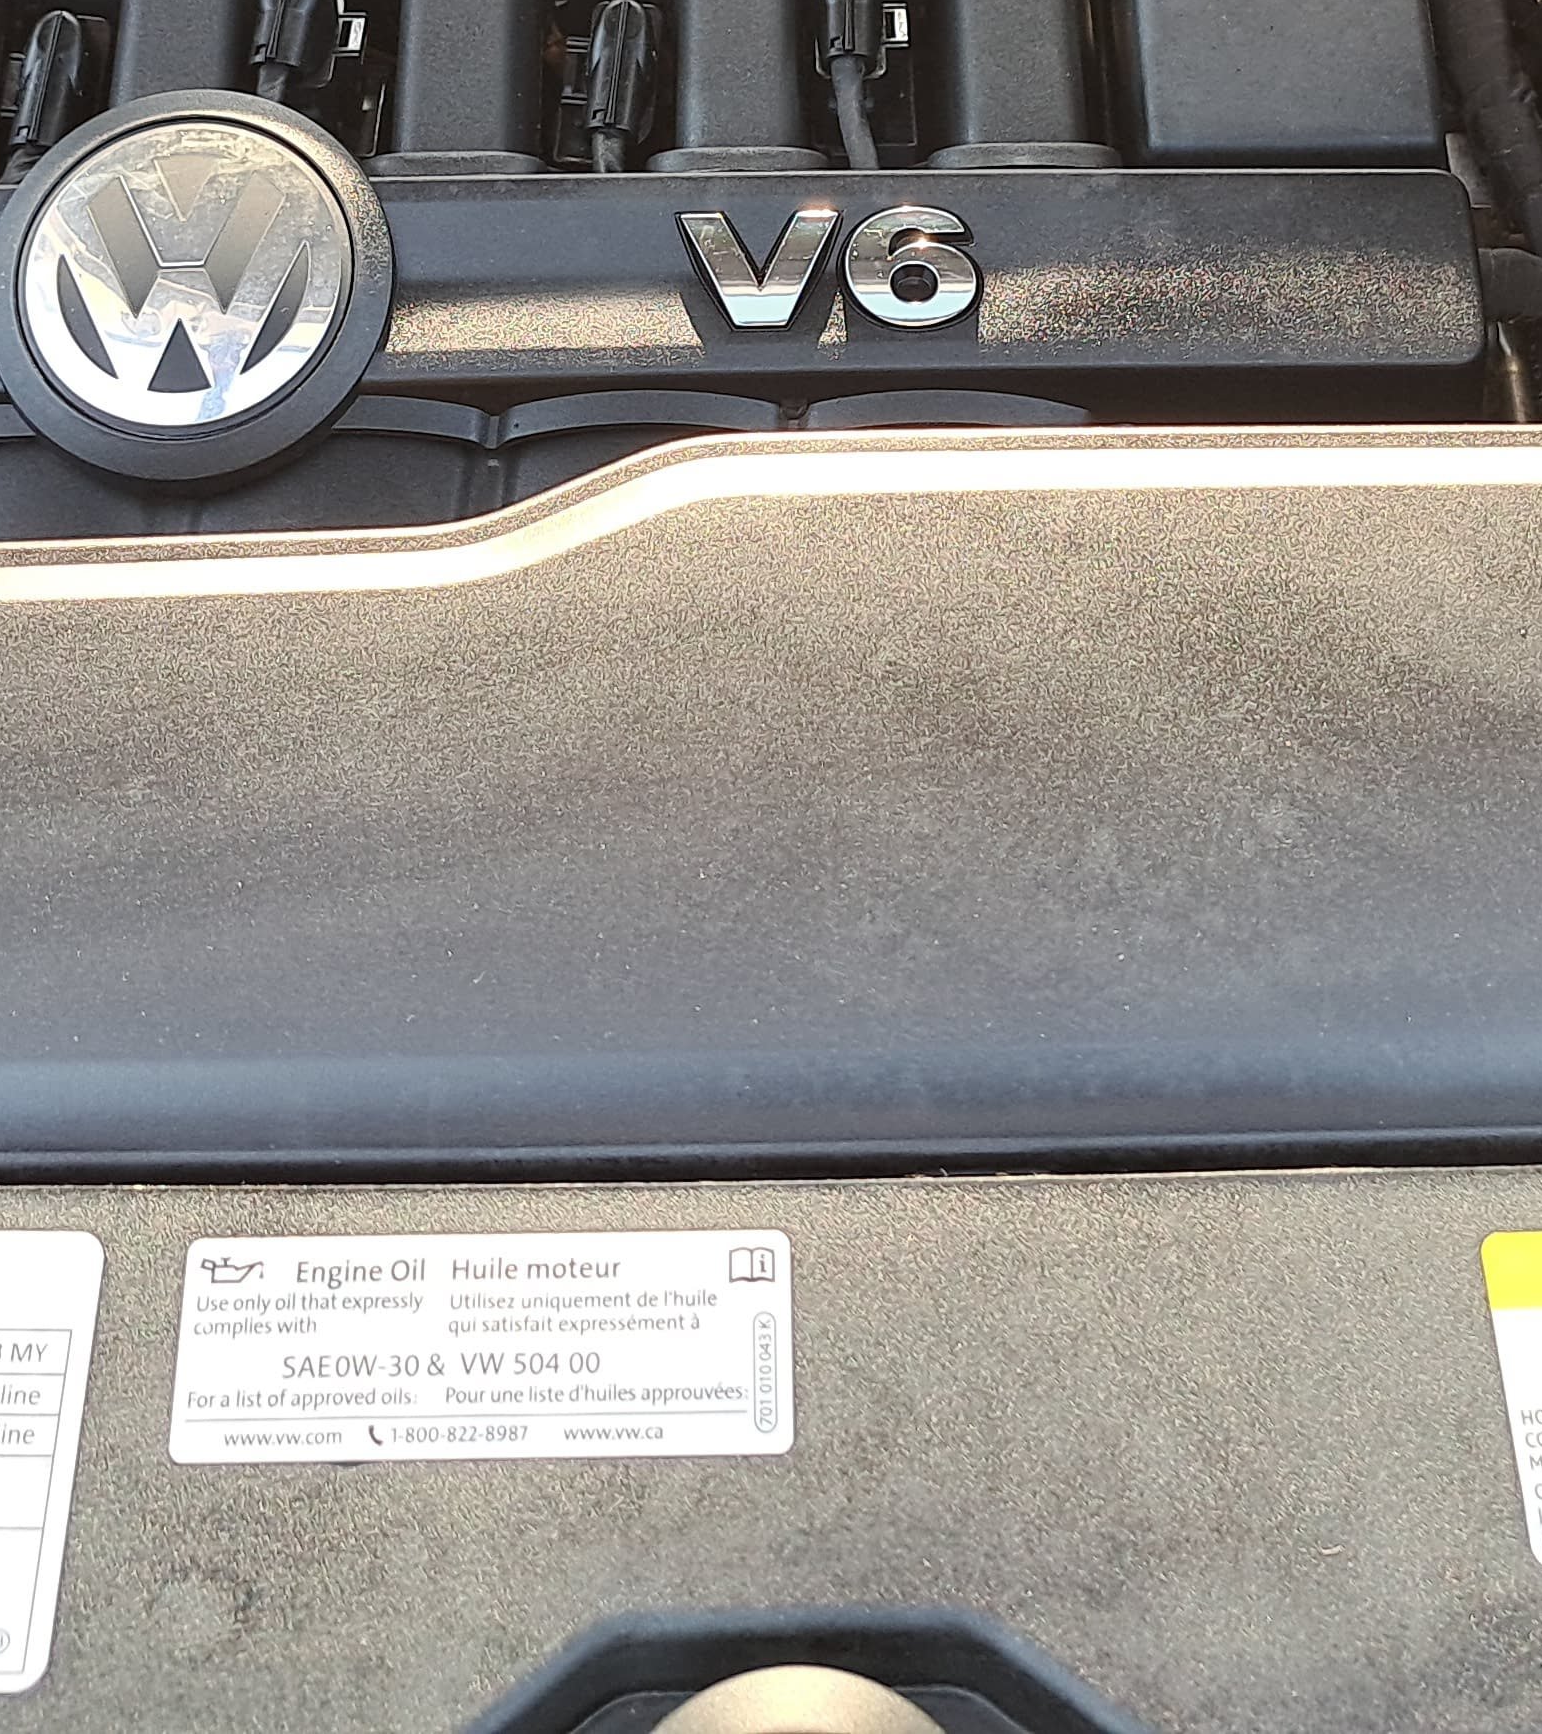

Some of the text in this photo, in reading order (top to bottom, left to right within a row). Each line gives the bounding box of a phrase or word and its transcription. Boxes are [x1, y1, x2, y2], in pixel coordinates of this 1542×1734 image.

[673, 206, 982, 333] V6
[296, 1258, 425, 1290] Engine Oil
[452, 1257, 621, 1281] Huile moteur
[197, 1291, 424, 1316] Use only oil that expressly
[451, 1289, 718, 1314] Utilisez uniquement de l'huile
[193, 1315, 317, 1340] complies with
[448, 1314, 685, 1338] qui satisfait expressément
[10, 1342, 48, 1362] MY
[427, 1353, 445, 1376] &
[460, 1352, 505, 1375] VW
[513, 1352, 559, 1375] 504
[569, 1352, 600, 1374] 00
[188, 1391, 216, 1409] For
[236, 1389, 262, 1408] list
[268, 1388, 287, 1408] of
[291, 1387, 376, 1411] approved
[446, 1386, 486, 1404] Pour
[491, 1390, 524, 1403] une
[529, 1386, 565, 1402] liste
[569, 1383, 637, 1402] d'huiles
[224, 1425, 663, 1447] www.vw.com 1-800-822-8987 www.vw.ca
